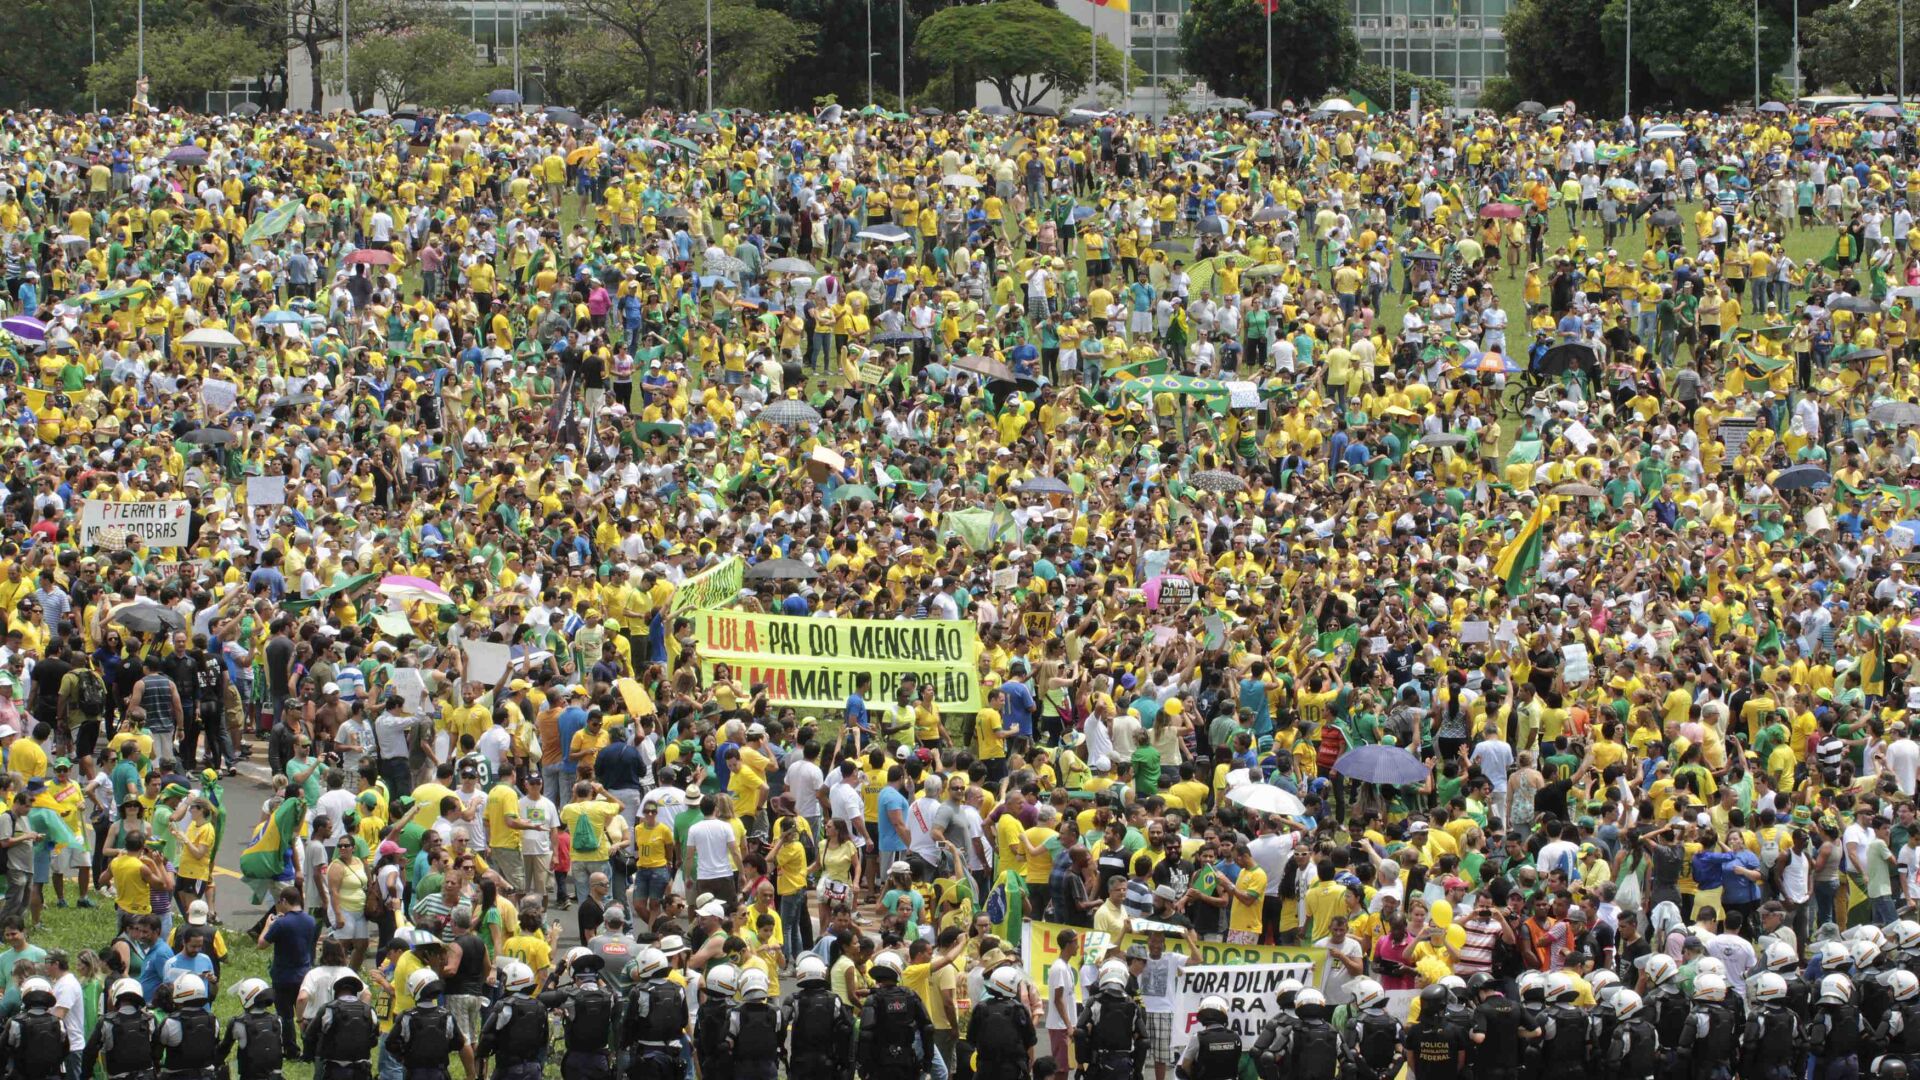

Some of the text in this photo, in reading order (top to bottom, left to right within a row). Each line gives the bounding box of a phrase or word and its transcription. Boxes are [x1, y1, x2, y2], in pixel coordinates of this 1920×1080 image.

[158, 503, 166, 518] A
[769, 621, 800, 655] PAI
[808, 624, 838, 656] DO
[850, 623, 962, 661] MENSALÃO
[1303, 705, 1321, 722] 10
[1183, 972, 1230, 993] FORA
